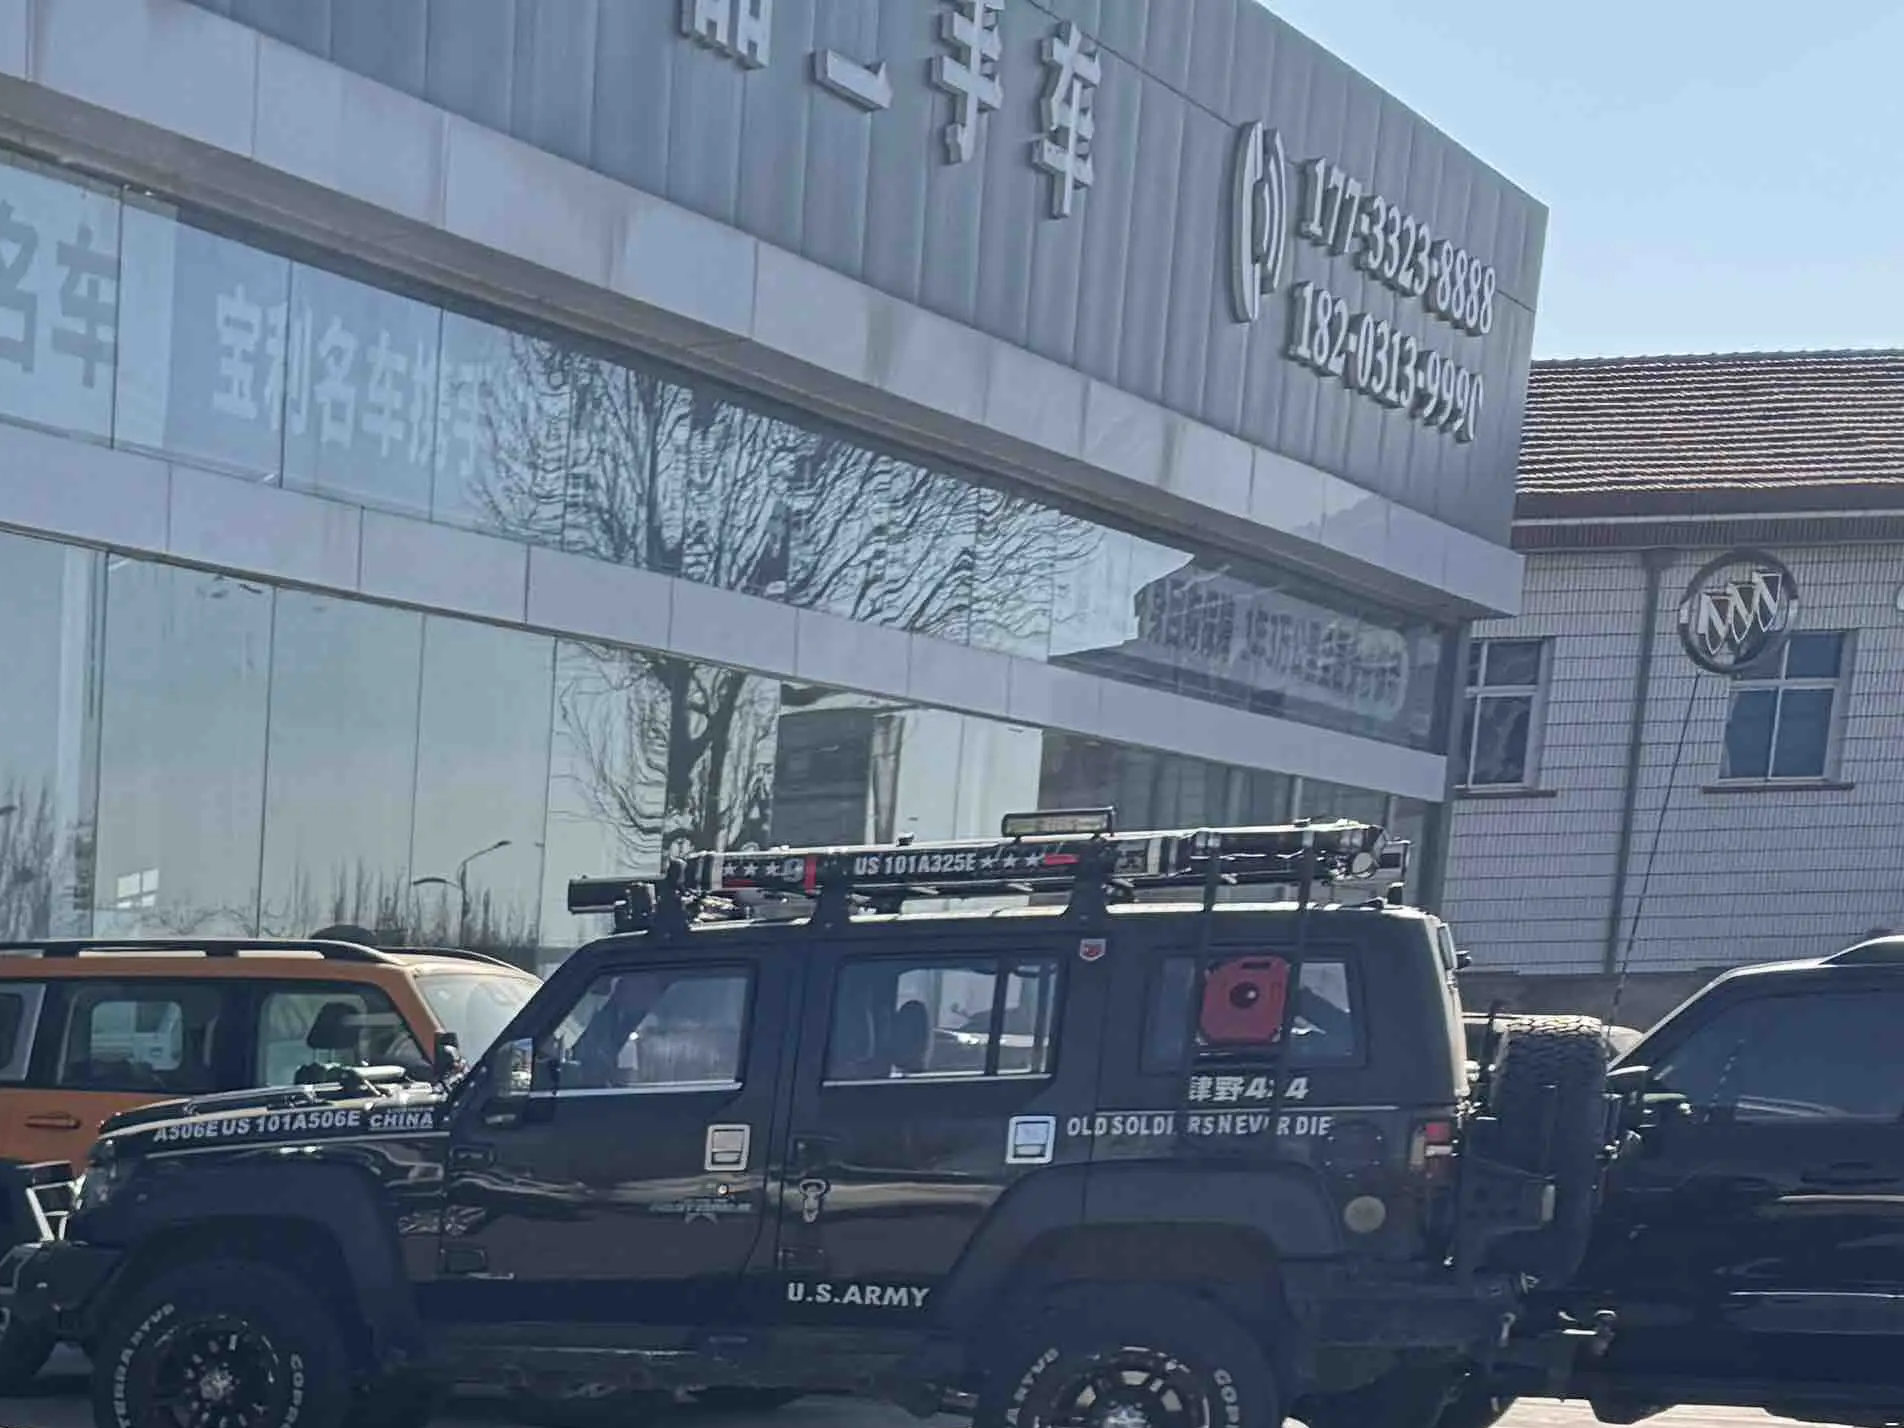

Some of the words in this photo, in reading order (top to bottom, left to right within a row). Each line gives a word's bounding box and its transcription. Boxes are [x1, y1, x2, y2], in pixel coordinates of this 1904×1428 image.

[853, 855, 880, 876] US
[884, 853, 977, 875] 101A325E
[369, 1110, 434, 1129] CHINA
[1067, 1117, 1106, 1136] OLD
[1111, 1114, 1214, 1136] SOLDIRS
[1218, 1113, 1290, 1135] NEVR
